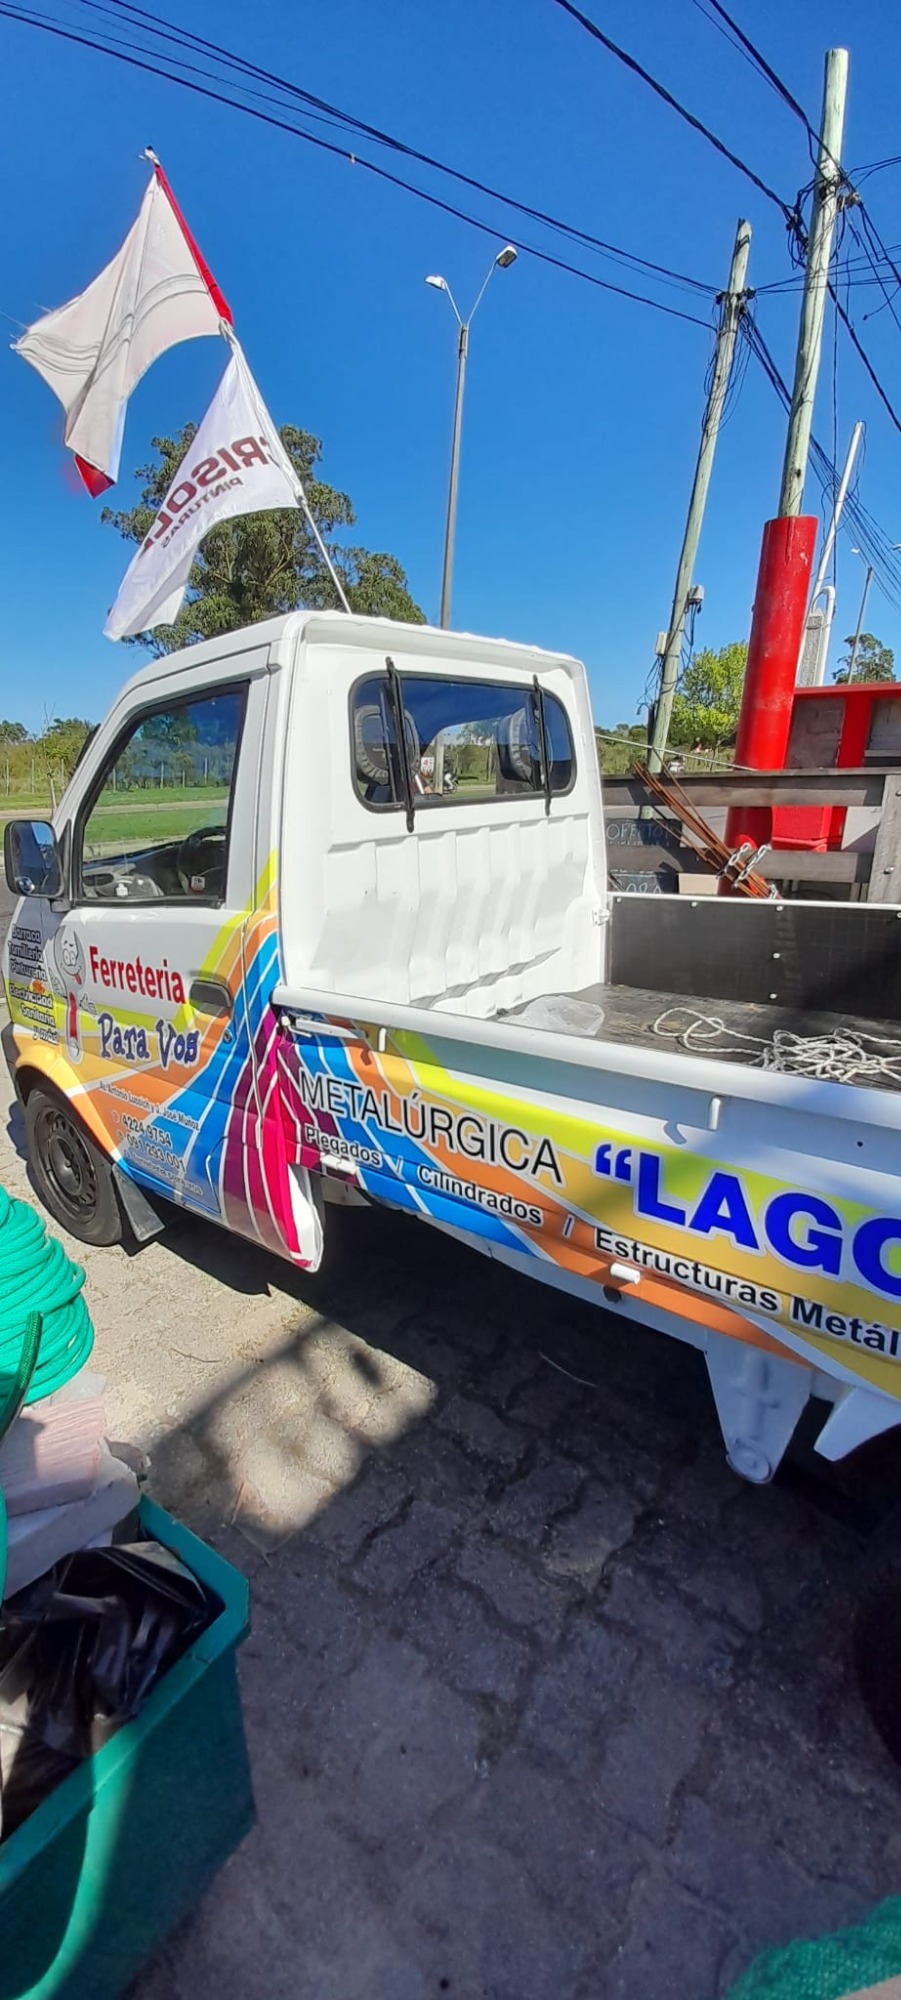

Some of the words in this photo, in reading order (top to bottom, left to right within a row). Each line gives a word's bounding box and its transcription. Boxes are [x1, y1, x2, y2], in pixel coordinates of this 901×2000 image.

[12, 925, 41, 944] Barraca
[90, 945, 186, 1004] Ferreteria
[98, 1012, 150, 1060] Para
[156, 1019, 199, 1068] Vos
[122, 1114, 145, 1135] 4224
[147, 1124, 173, 1147] 9754
[301, 1071, 563, 1184] METALÚRGICA
[306, 1125, 382, 1166] Plegados
[418, 1165, 543, 1225] Cilindrados
[596, 1228, 779, 1313] Estructuras
[792, 1297, 900, 1357] Metál
